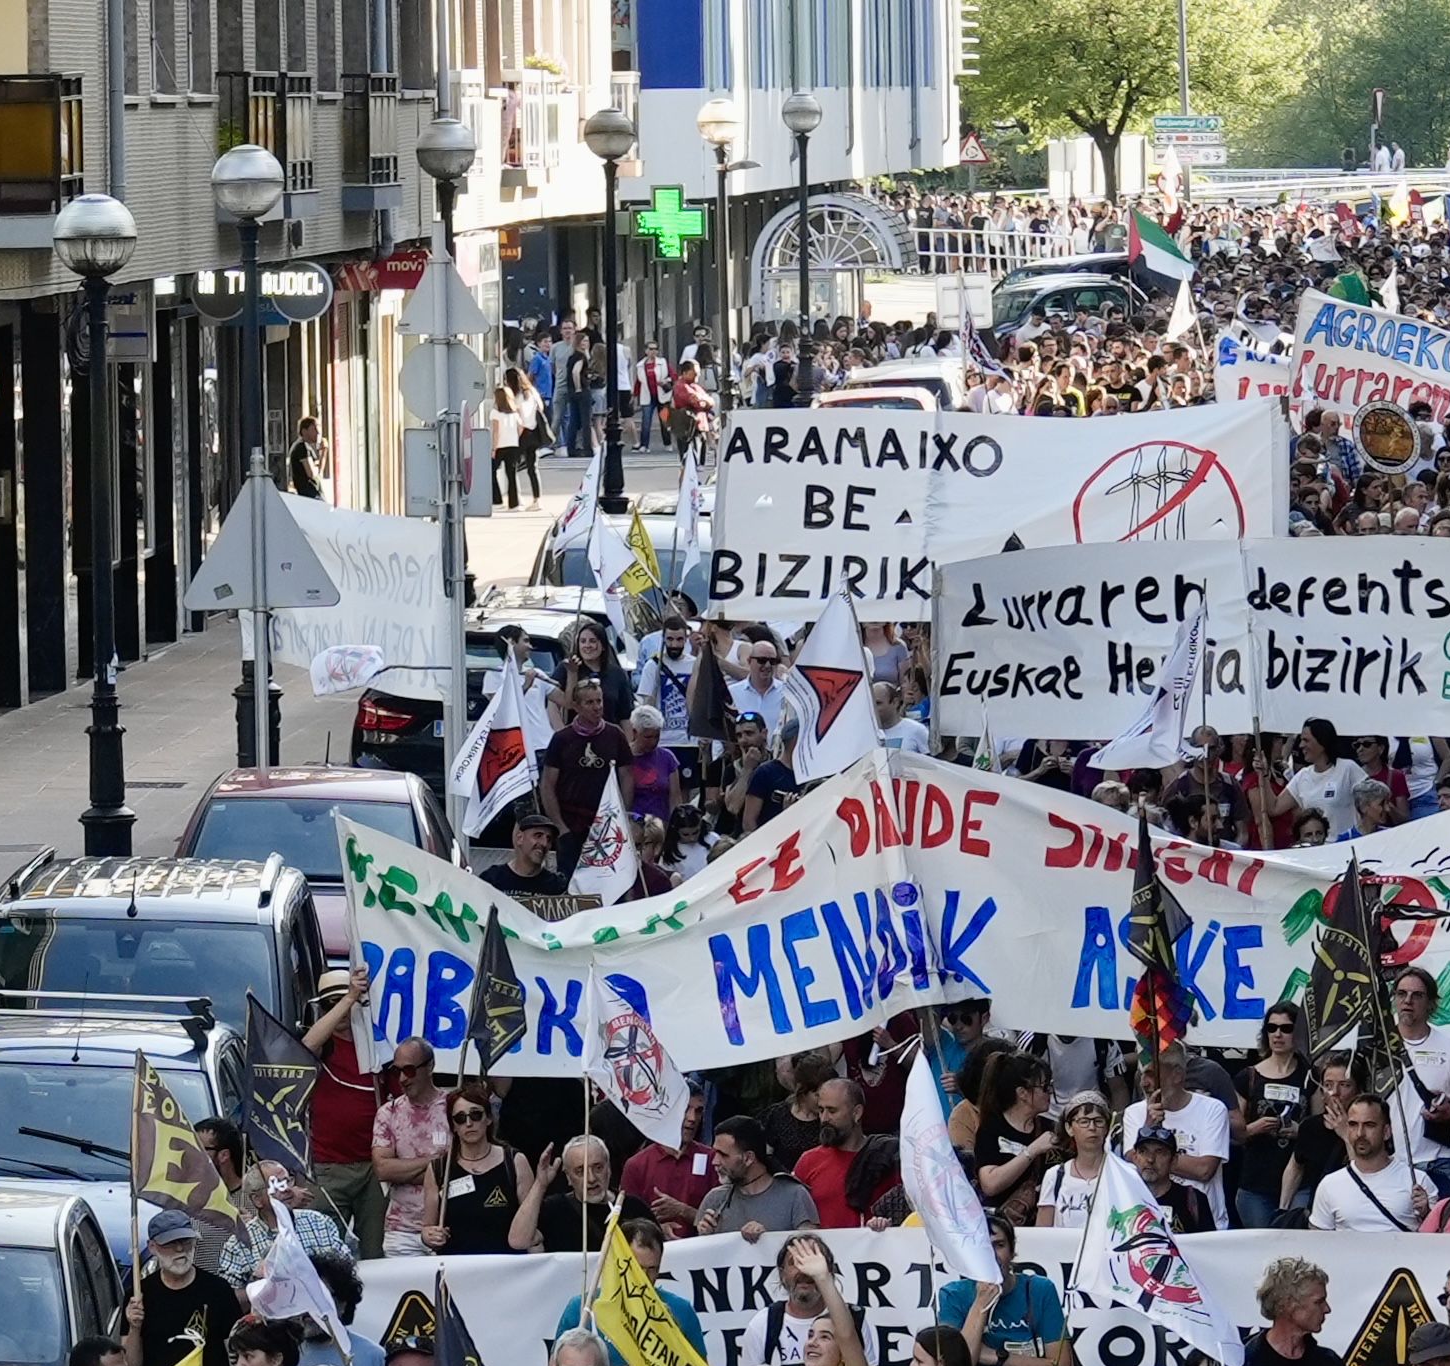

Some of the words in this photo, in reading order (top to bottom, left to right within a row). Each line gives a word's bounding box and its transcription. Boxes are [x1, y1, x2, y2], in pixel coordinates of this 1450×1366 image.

[724, 426, 1004, 478] ARAMAIXO
[803, 484, 876, 531] BE
[709, 549, 932, 600] BIZIRIK
[961, 574, 1206, 632] Lurraren
[1108, 637, 1246, 697] Heia
[1266, 629, 1428, 701] bizirik
